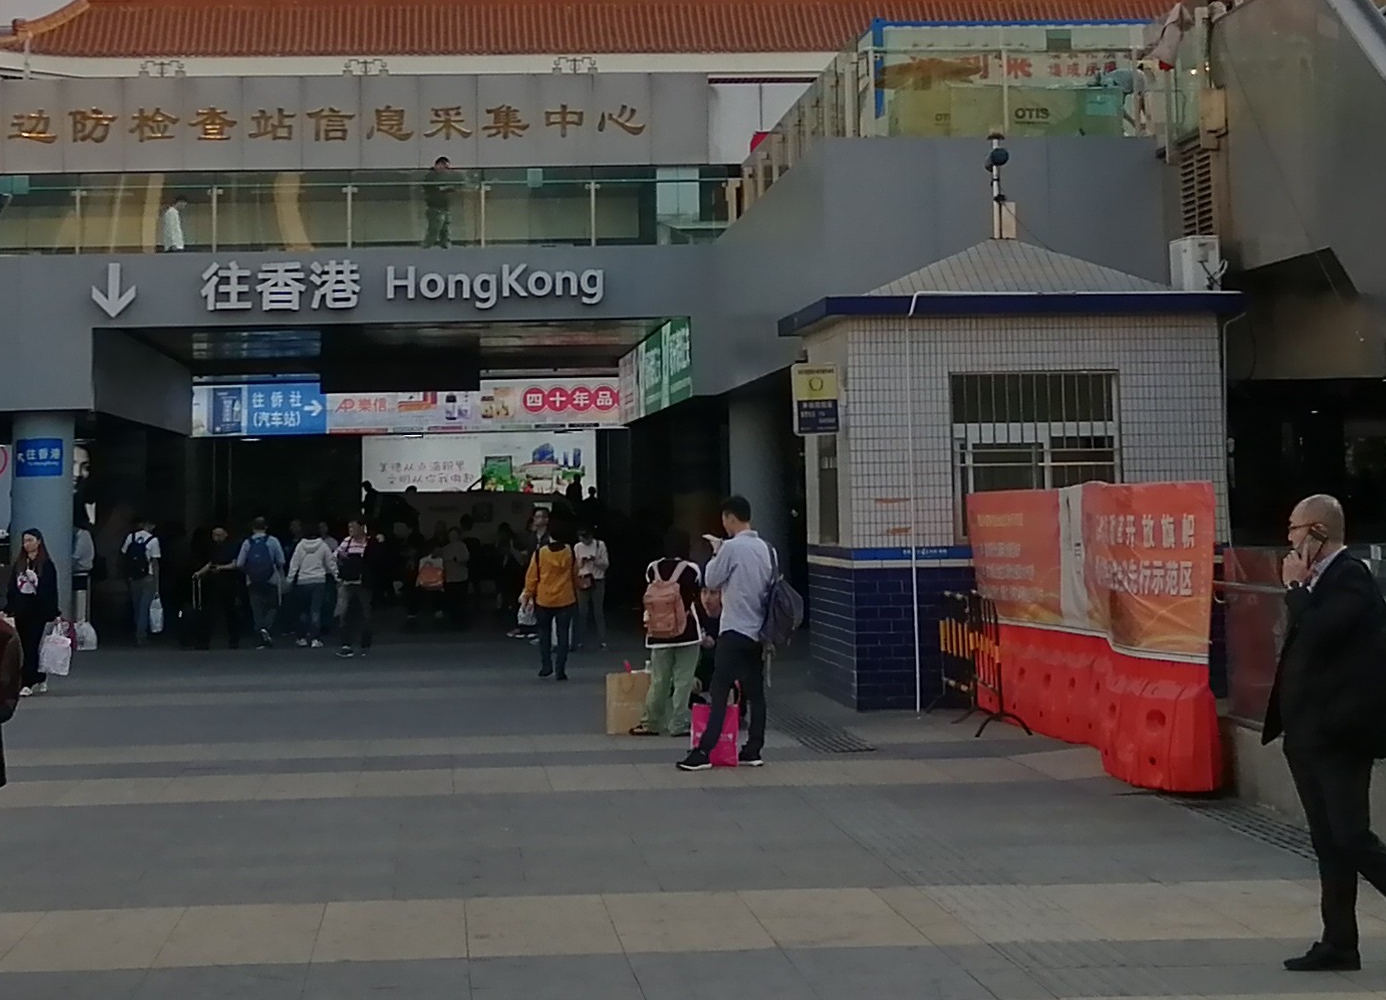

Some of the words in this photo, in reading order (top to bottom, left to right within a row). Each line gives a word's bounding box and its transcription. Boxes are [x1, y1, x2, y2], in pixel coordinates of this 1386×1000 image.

[1014, 106, 1051, 120] OTIS
[200, 259, 361, 313] 往香港
[385, 262, 606, 310] HongKong
[251, 390, 303, 409] 往侨社
[26, 448, 62, 460] 往香港
